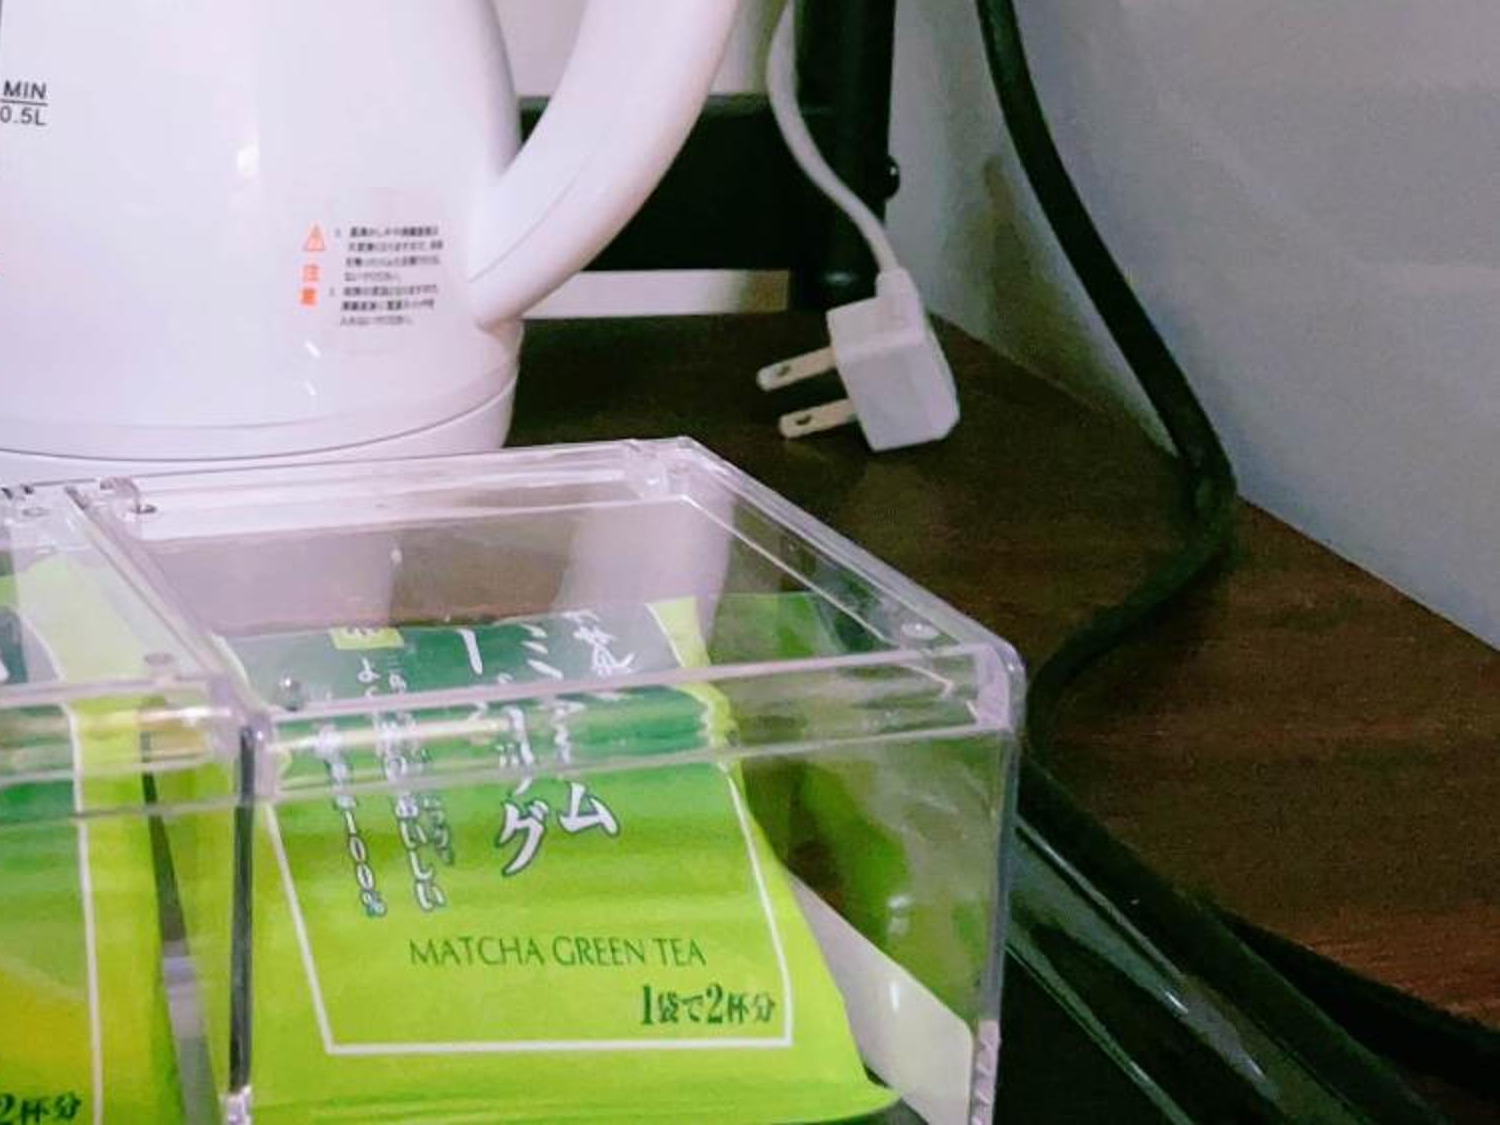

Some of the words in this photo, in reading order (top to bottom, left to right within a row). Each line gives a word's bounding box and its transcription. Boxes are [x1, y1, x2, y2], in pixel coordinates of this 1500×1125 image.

[3, 80, 47, 100] MIN
[0, 105, 47, 126] 0.5L
[408, 935, 546, 967] MATCHA
[551, 934, 647, 967] GREEN
[656, 937, 707, 967] TEA
